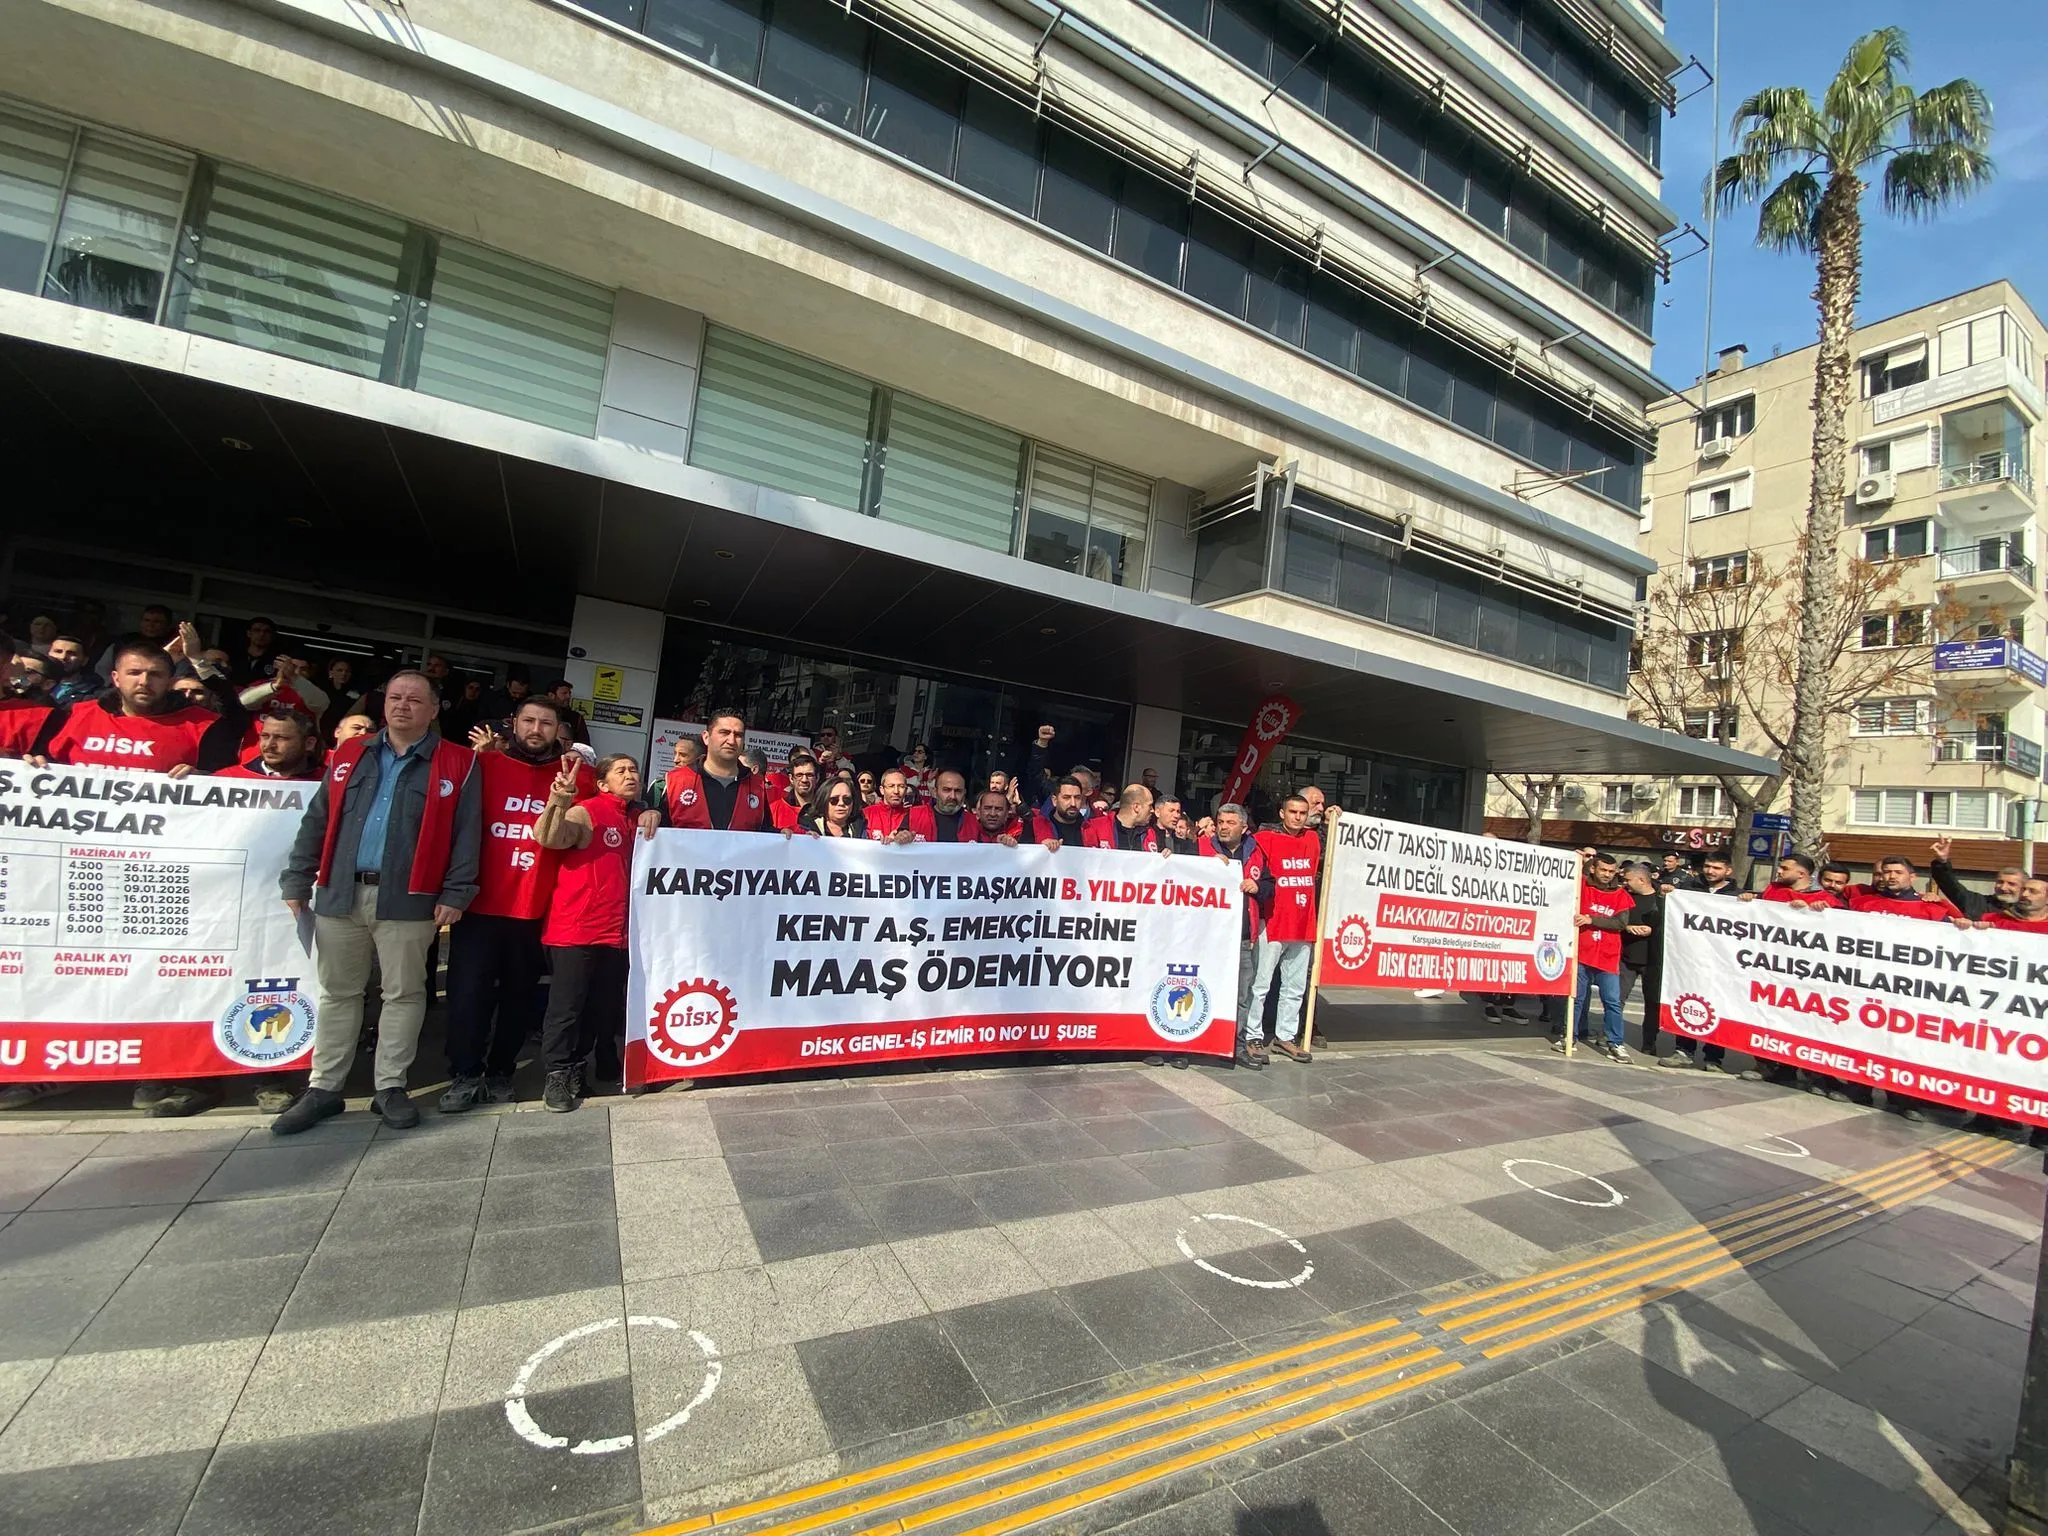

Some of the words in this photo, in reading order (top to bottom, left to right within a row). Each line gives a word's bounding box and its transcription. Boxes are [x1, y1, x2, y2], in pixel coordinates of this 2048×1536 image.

[83, 734, 156, 756] DİSK
[31, 773, 304, 811] ÇALIŞANLARINA
[504, 794, 546, 815] DİS
[0, 804, 167, 836] MAAŞLAR
[491, 822, 536, 840] GEN
[69, 847, 126, 859] HAZİRAN
[129, 850, 152, 859] AYI
[510, 846, 536, 871] İŞ
[1338, 821, 1394, 852] TAKSİT
[1398, 831, 1448, 861] TAKSİT
[1451, 841, 1492, 874] MAAŞ
[1495, 842, 1576, 880] İSTEMİYORUZ
[69, 861, 103, 870] 4.500
[123, 863, 190, 874] 26.12.2025
[1282, 857, 1311, 869] DİSK
[68, 871, 103, 881] 7.000
[123, 873, 190, 884] 30.12.2025
[68, 882, 104, 891] 6.000
[123, 884, 190, 894] 09.01.2026
[645, 867, 822, 901] KARŞIYAKA
[827, 869, 951, 900] BELEDİYE
[956, 876, 1057, 904] BAŞKANI
[1061, 878, 1082, 901] B.
[1088, 879, 1157, 904] YILDIZ
[1161, 880, 1232, 909] ÜNSAL
[1277, 875, 1314, 888] GENEL
[1366, 862, 1400, 890] ZAM
[1404, 864, 1448, 896] DEĞİL
[1451, 875, 1509, 903] SADAKA
[1513, 878, 1550, 907] DEĞİL
[68, 892, 104, 902] 5.500
[123, 894, 190, 905] 16.01.2026
[68, 903, 104, 912] 6.500
[122, 905, 189, 915] 23.01.2026
[1295, 891, 1307, 908] İŞ
[66, 924, 103, 934] 9.000
[122, 926, 189, 936] 06.02.2026
[67, 914, 104, 923] 6.500
[122, 915, 189, 926] 30.01.2026
[775, 914, 870, 942] KENT
[874, 916, 935, 947] A.Ş.
[942, 909, 1137, 943] EMEKÇİLERİNE
[1382, 903, 1458, 929] HAKKIMIZI
[1461, 908, 1531, 937] İSTİYORUZ
[1342, 932, 1364, 947] DİSK
[1683, 913, 1829, 952] KARŞIYAKA
[1836, 935, 2019, 981] BELEDİYESİ
[54, 953, 107, 963] ARALIK
[109, 954, 132, 963] AYI
[159, 955, 197, 964] OCAK
[201, 955, 224, 964] AYI
[1377, 947, 1408, 977] DİSK
[1408, 951, 1455, 987] GENEL-İŞ
[1456, 956, 1467, 981] 10
[1500, 961, 1528, 990] ŞUBE
[55, 964, 129, 977] ÖDENMEDİ
[158, 965, 232, 977] ÖDENMEDİ
[770, 959, 909, 1001] MAAŞ
[917, 946, 1133, 992] ÖDEMİYOR!
[1736, 950, 1971, 1007] ÇALIŞANLARINA
[1980, 989, 2000, 1010] 7
[1166, 976, 1198, 990] GENEL-İŞ
[246, 991, 299, 1006] GENEL-İŞ
[1750, 980, 1850, 1025] MAAŞ
[224, 1002, 247, 1030] TÜRKİYE
[297, 998, 315, 1031] SENDİKASI
[669, 1005, 719, 1028] DİSK
[1682, 1004, 1706, 1019] DİSK
[224, 1030, 240, 1051] GENEL
[286, 1031, 312, 1054] İŞÇİLERİ
[800, 1036, 846, 1057] DİSK
[849, 1027, 926, 1056] GENEL-İŞ
[930, 1024, 974, 1046] İZMİR
[977, 1026, 996, 1043] 10
[1030, 1024, 1050, 1040] LU
[1056, 1025, 1097, 1042] ŞUBE
[0, 1039, 27, 1066] U
[44, 1039, 143, 1071] ŞUBE
[239, 1048, 286, 1061] HİZMETLER
[1750, 1032, 1793, 1057] DİSK
[1795, 1045, 1886, 1082] GENEL-İŞ
[1890, 1067, 1914, 1087] 10
[1965, 1085, 1996, 1106] LU
